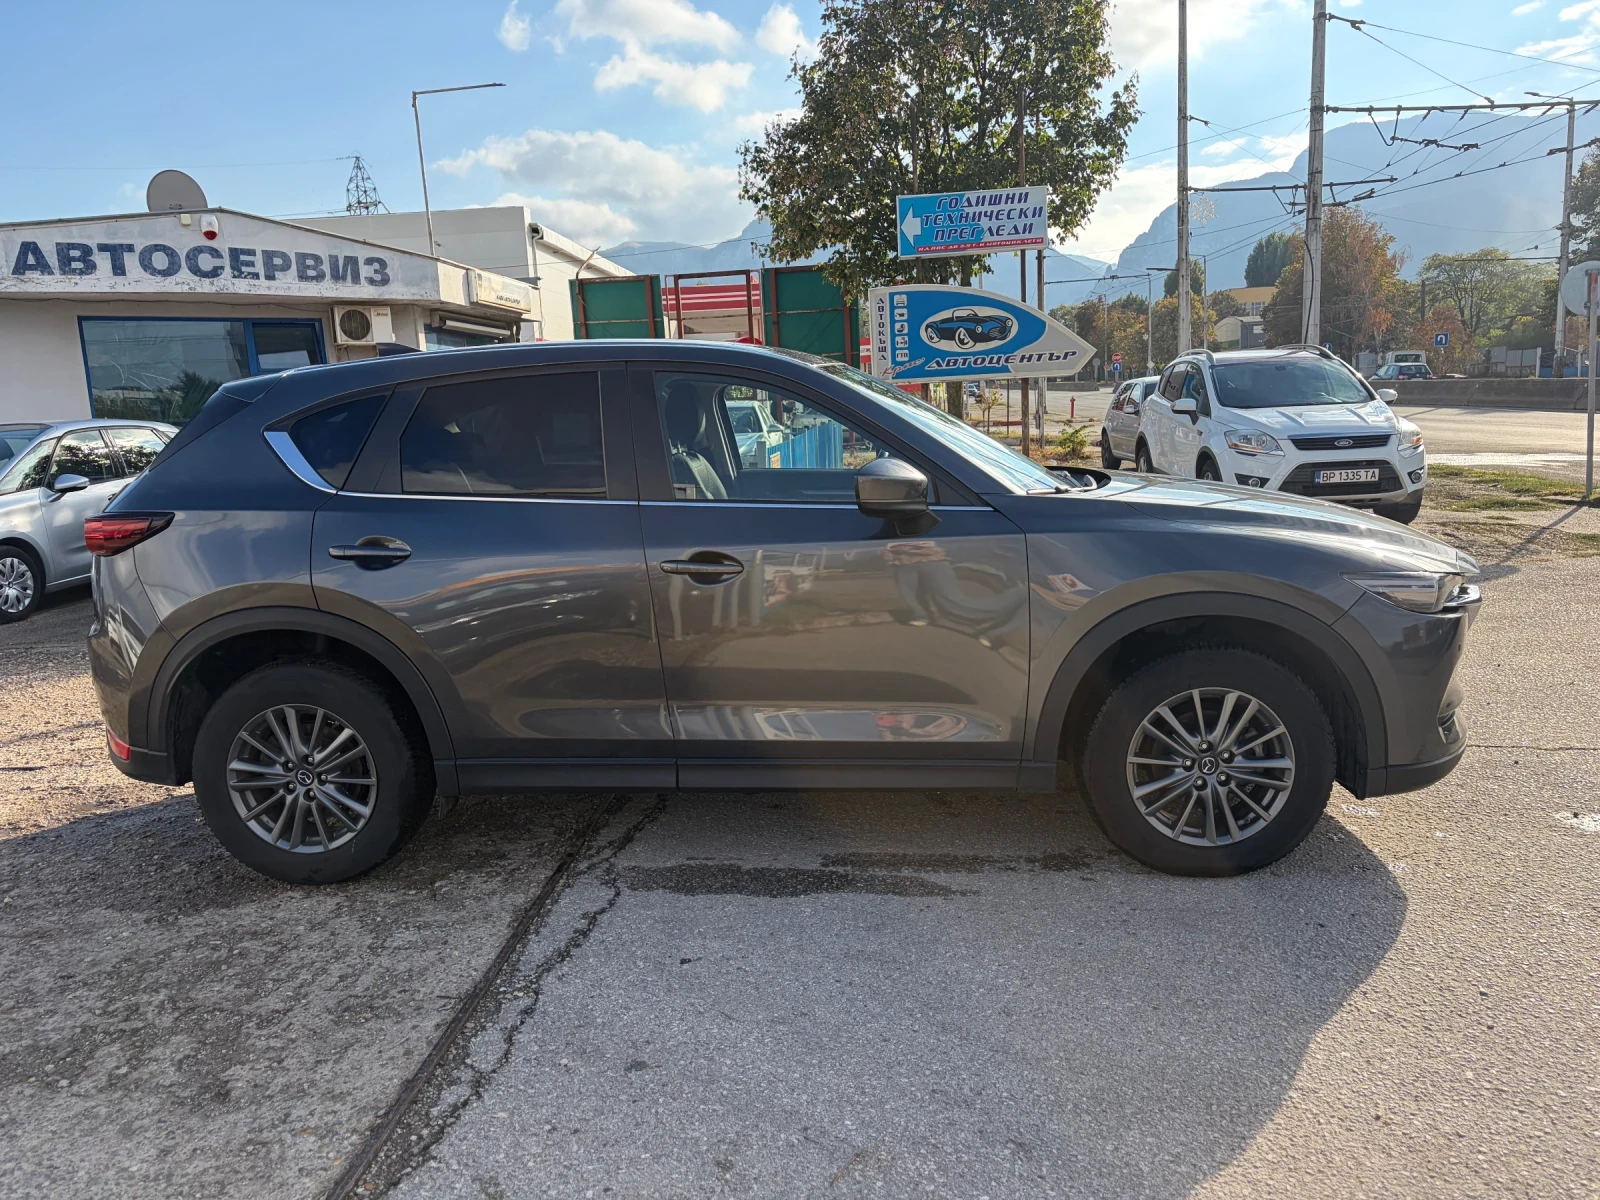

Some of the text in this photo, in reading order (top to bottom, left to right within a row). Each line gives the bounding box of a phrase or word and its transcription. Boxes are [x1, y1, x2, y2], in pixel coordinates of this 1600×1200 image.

[936, 192, 1029, 210] ГОДИШНИ
[923, 206, 1043, 227] ТЕХНИЧЕСКИ
[933, 222, 1034, 241] ПРЕГЛЕДИ
[985, 238, 1042, 246] МОТОЦИКЛЕТИ
[11, 240, 391, 287] АВТОСЕРВИЗ
[876, 297, 887, 361] АВТОКЪЩА
[925, 350, 1078, 370] АВТОЦЕНТЪР
[1322, 470, 1376, 482] BP 1335 TA
